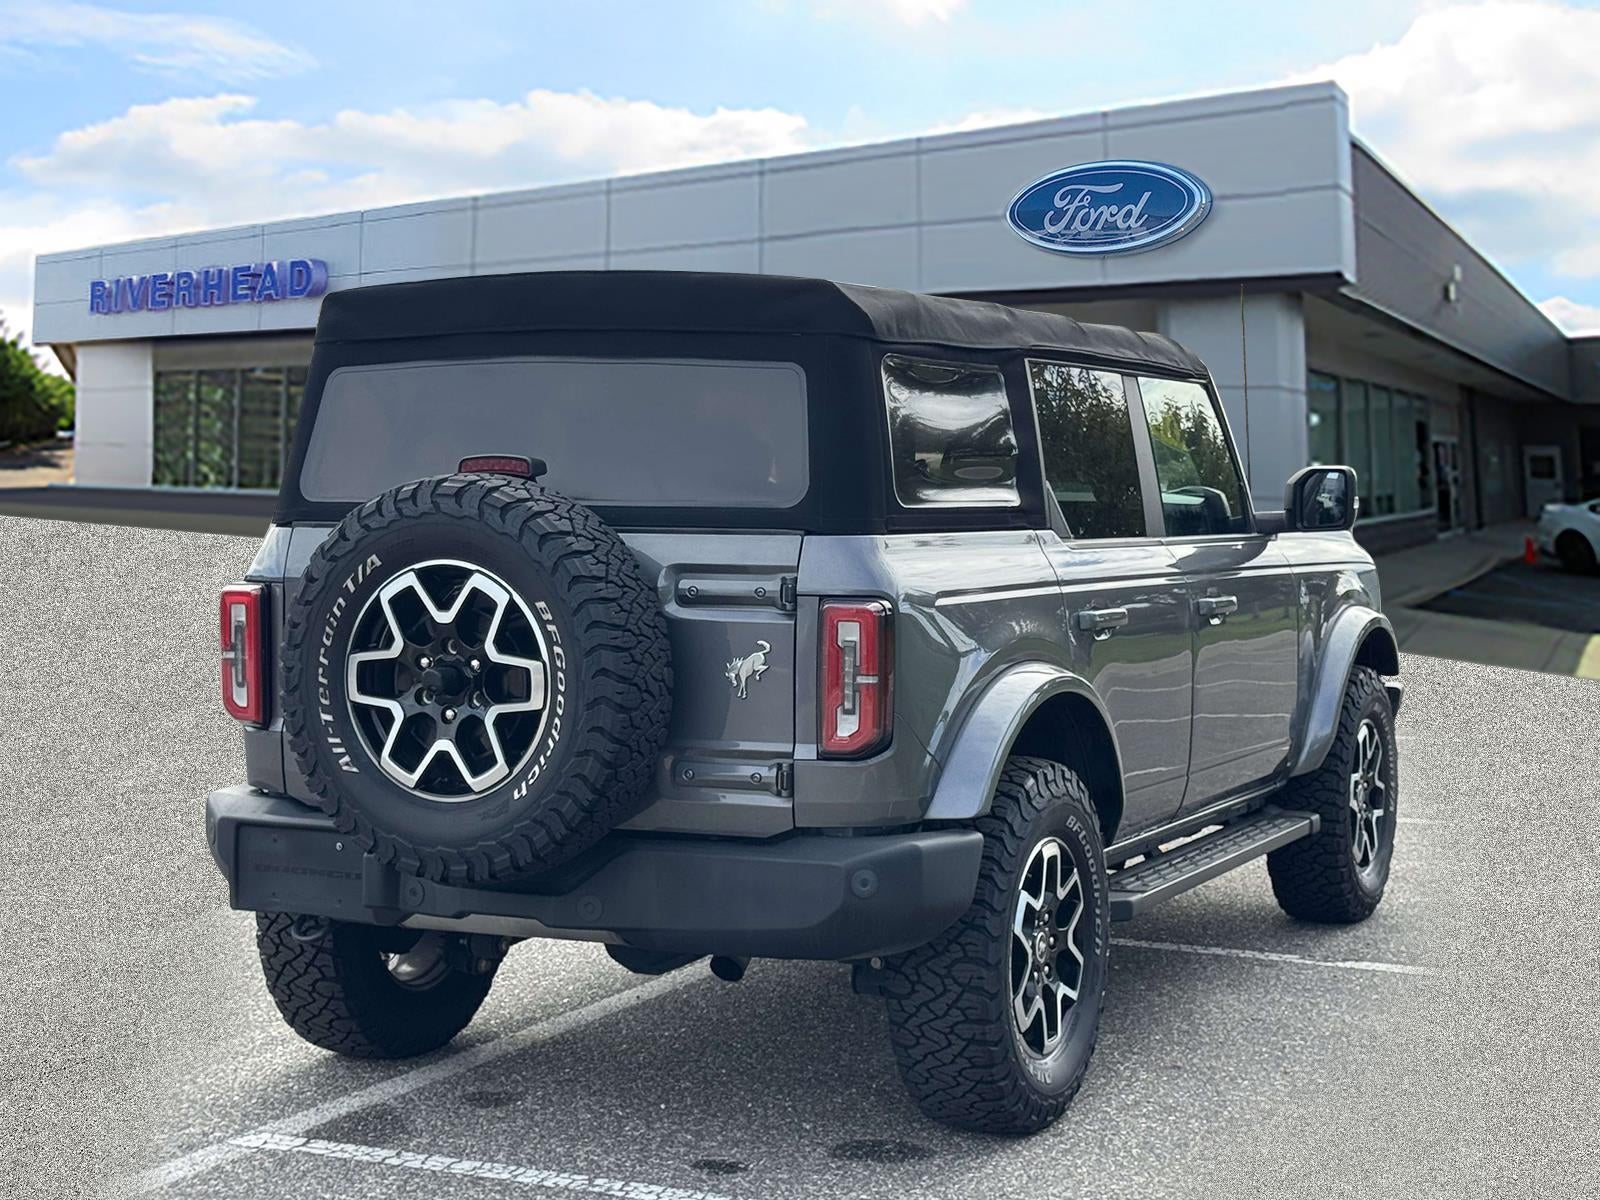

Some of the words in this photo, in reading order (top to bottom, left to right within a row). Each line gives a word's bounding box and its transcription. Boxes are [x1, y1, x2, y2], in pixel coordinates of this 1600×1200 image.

[1043, 183, 1152, 234] Ford
[89, 259, 326, 314] RIVERHEAD
[512, 600, 566, 801] BFGoodrich
